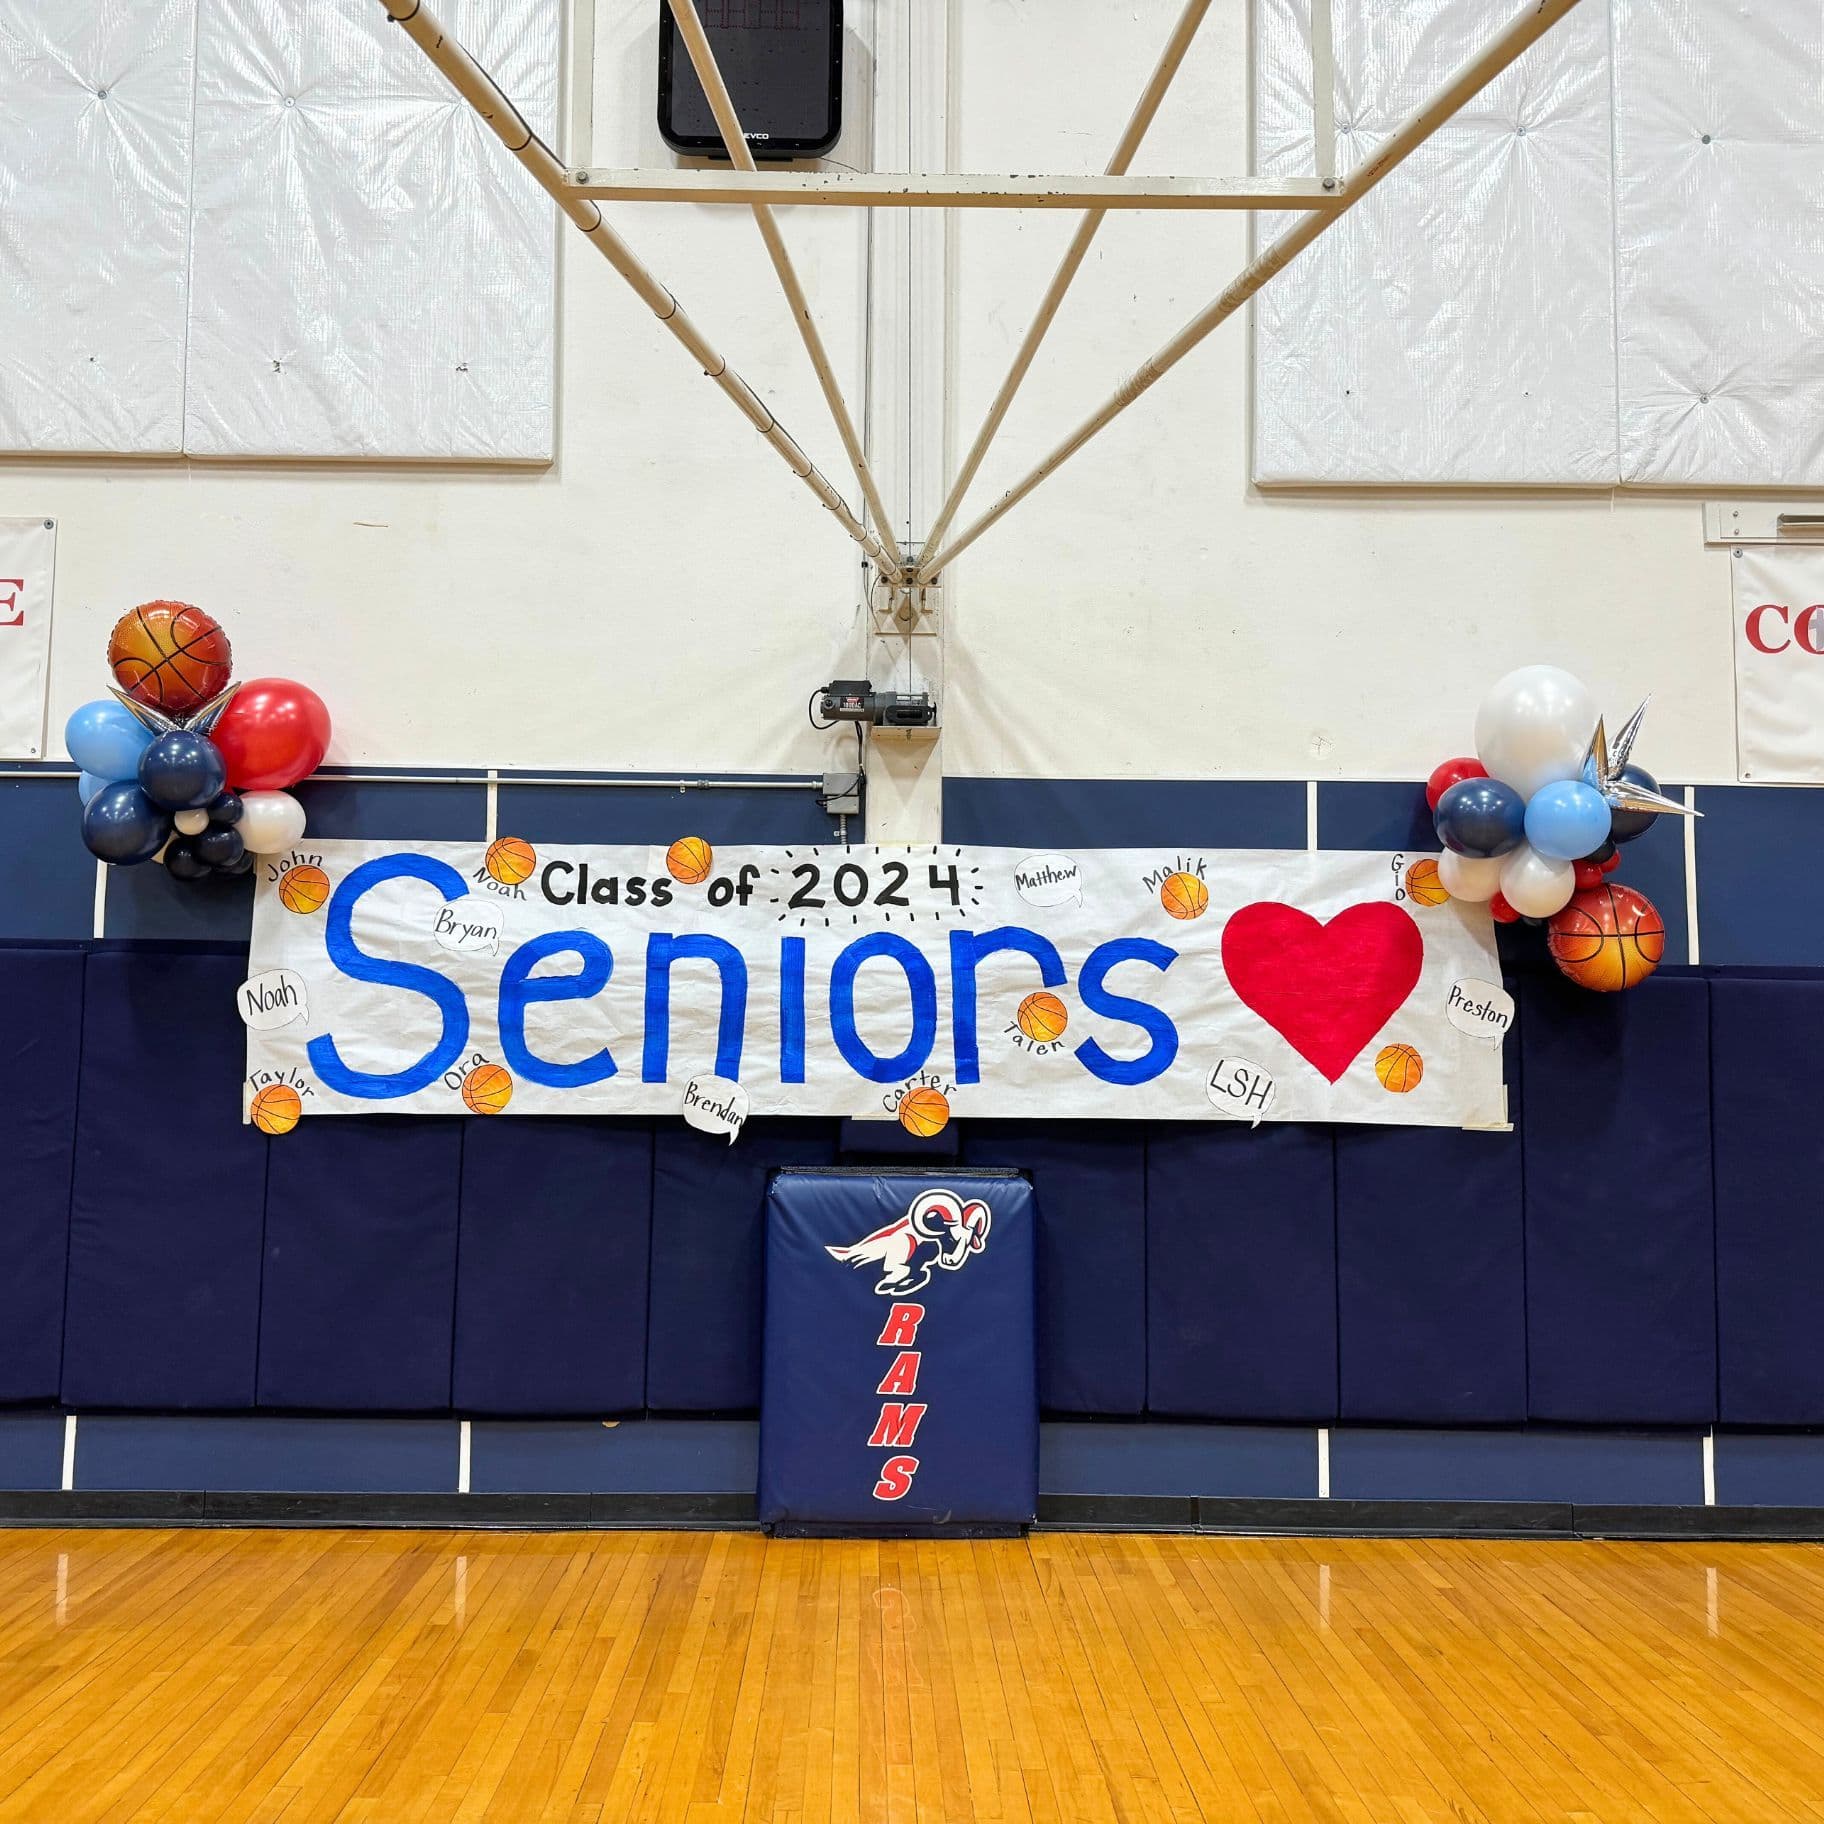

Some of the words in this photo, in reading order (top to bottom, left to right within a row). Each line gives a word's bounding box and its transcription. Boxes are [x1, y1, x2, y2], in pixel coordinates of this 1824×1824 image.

[743, 132, 769, 140] EVCO
[267, 850, 323, 882] John
[473, 866, 527, 901] Noah
[541, 860, 673, 907] Class
[707, 864, 761, 906] of
[788, 862, 960, 909] 2024
[1015, 864, 1077, 891] Matthew
[1142, 856, 1207, 894] Malik
[434, 908, 498, 943] Bryan
[306, 852, 1179, 1099] Seniors
[246, 975, 298, 1016] Noah
[1448, 985, 1508, 1029] Preston
[1003, 1020, 1066, 1056] Talen
[249, 1066, 315, 1097] Taylor
[444, 1052, 490, 1091] Ora
[882, 1069, 957, 1113] Carter
[1209, 1059, 1273, 1110] LSH
[684, 1081, 744, 1127] Brendan
[867, 1302, 927, 1501] RAMS
